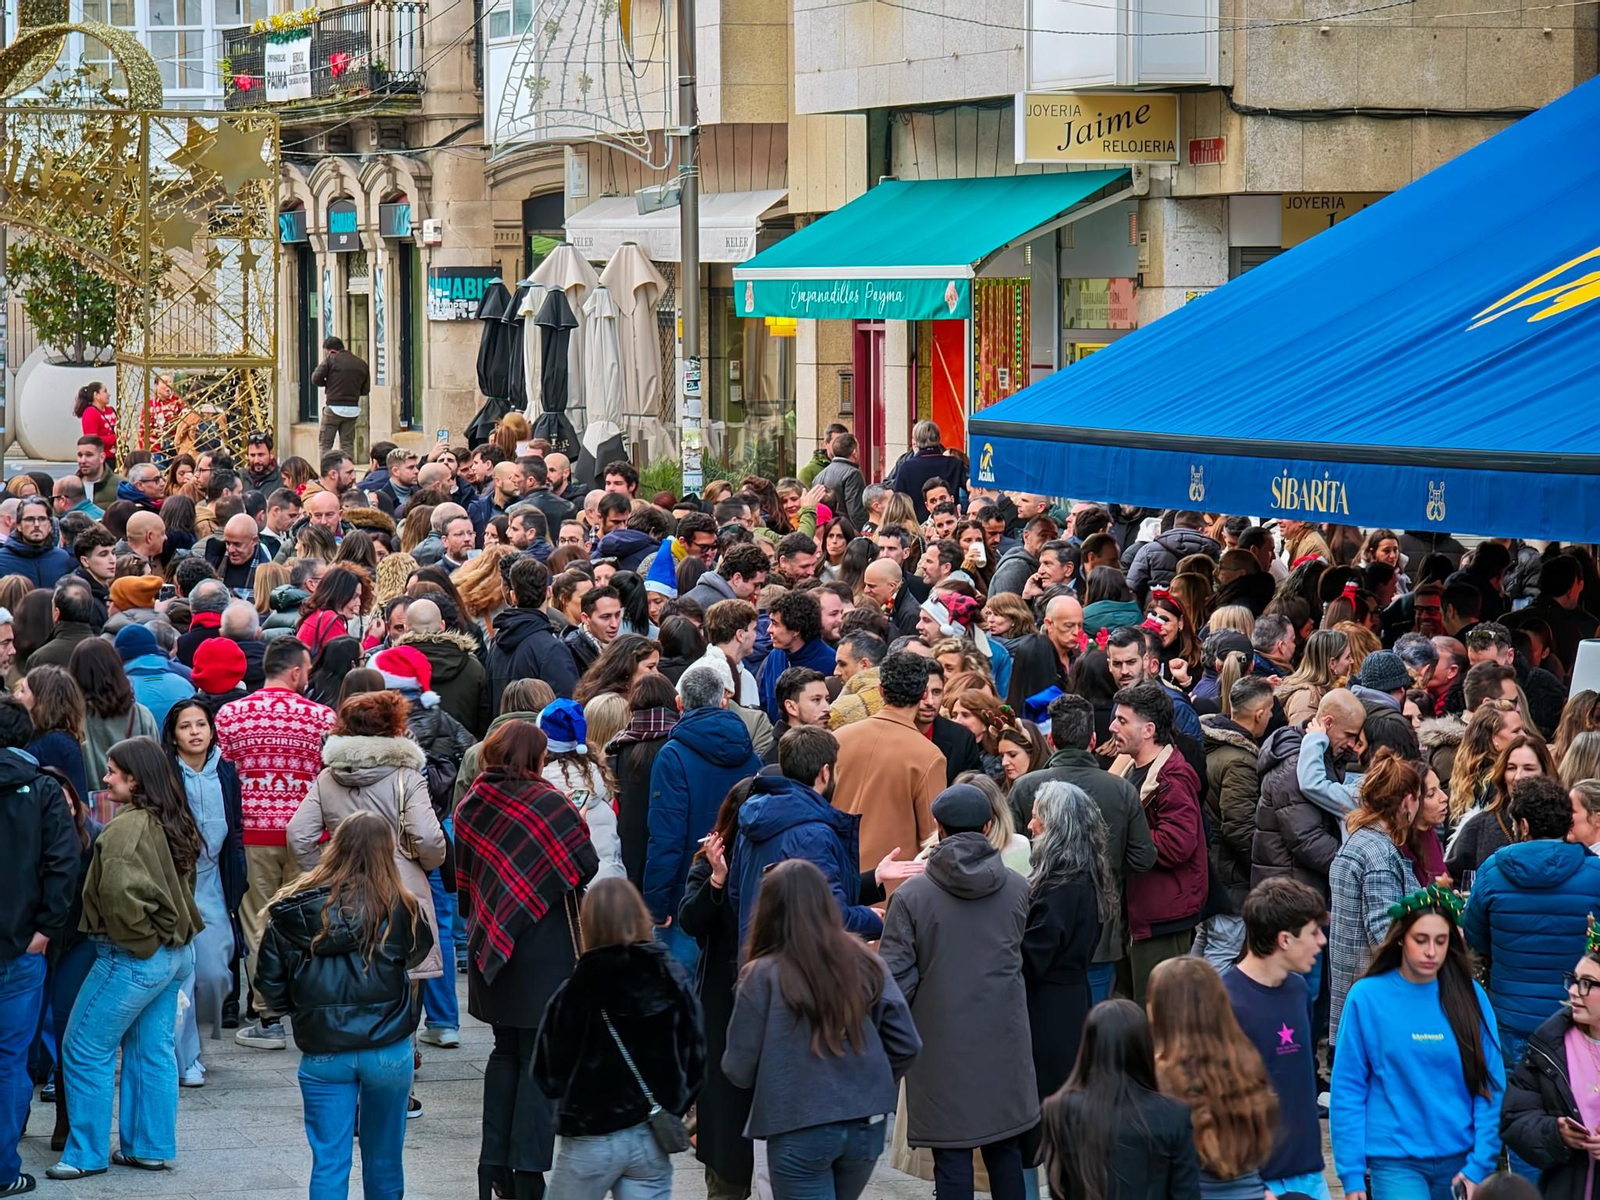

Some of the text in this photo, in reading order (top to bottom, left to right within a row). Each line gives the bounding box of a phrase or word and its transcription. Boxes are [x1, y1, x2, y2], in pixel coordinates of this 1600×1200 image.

[1027, 104, 1082, 117] JOYERIA
[1057, 104, 1151, 152] Jaime
[1103, 140, 1176, 153] RELOJERIA
[1286, 196, 1346, 210] JOYERIA
[725, 236, 749, 248] KELER
